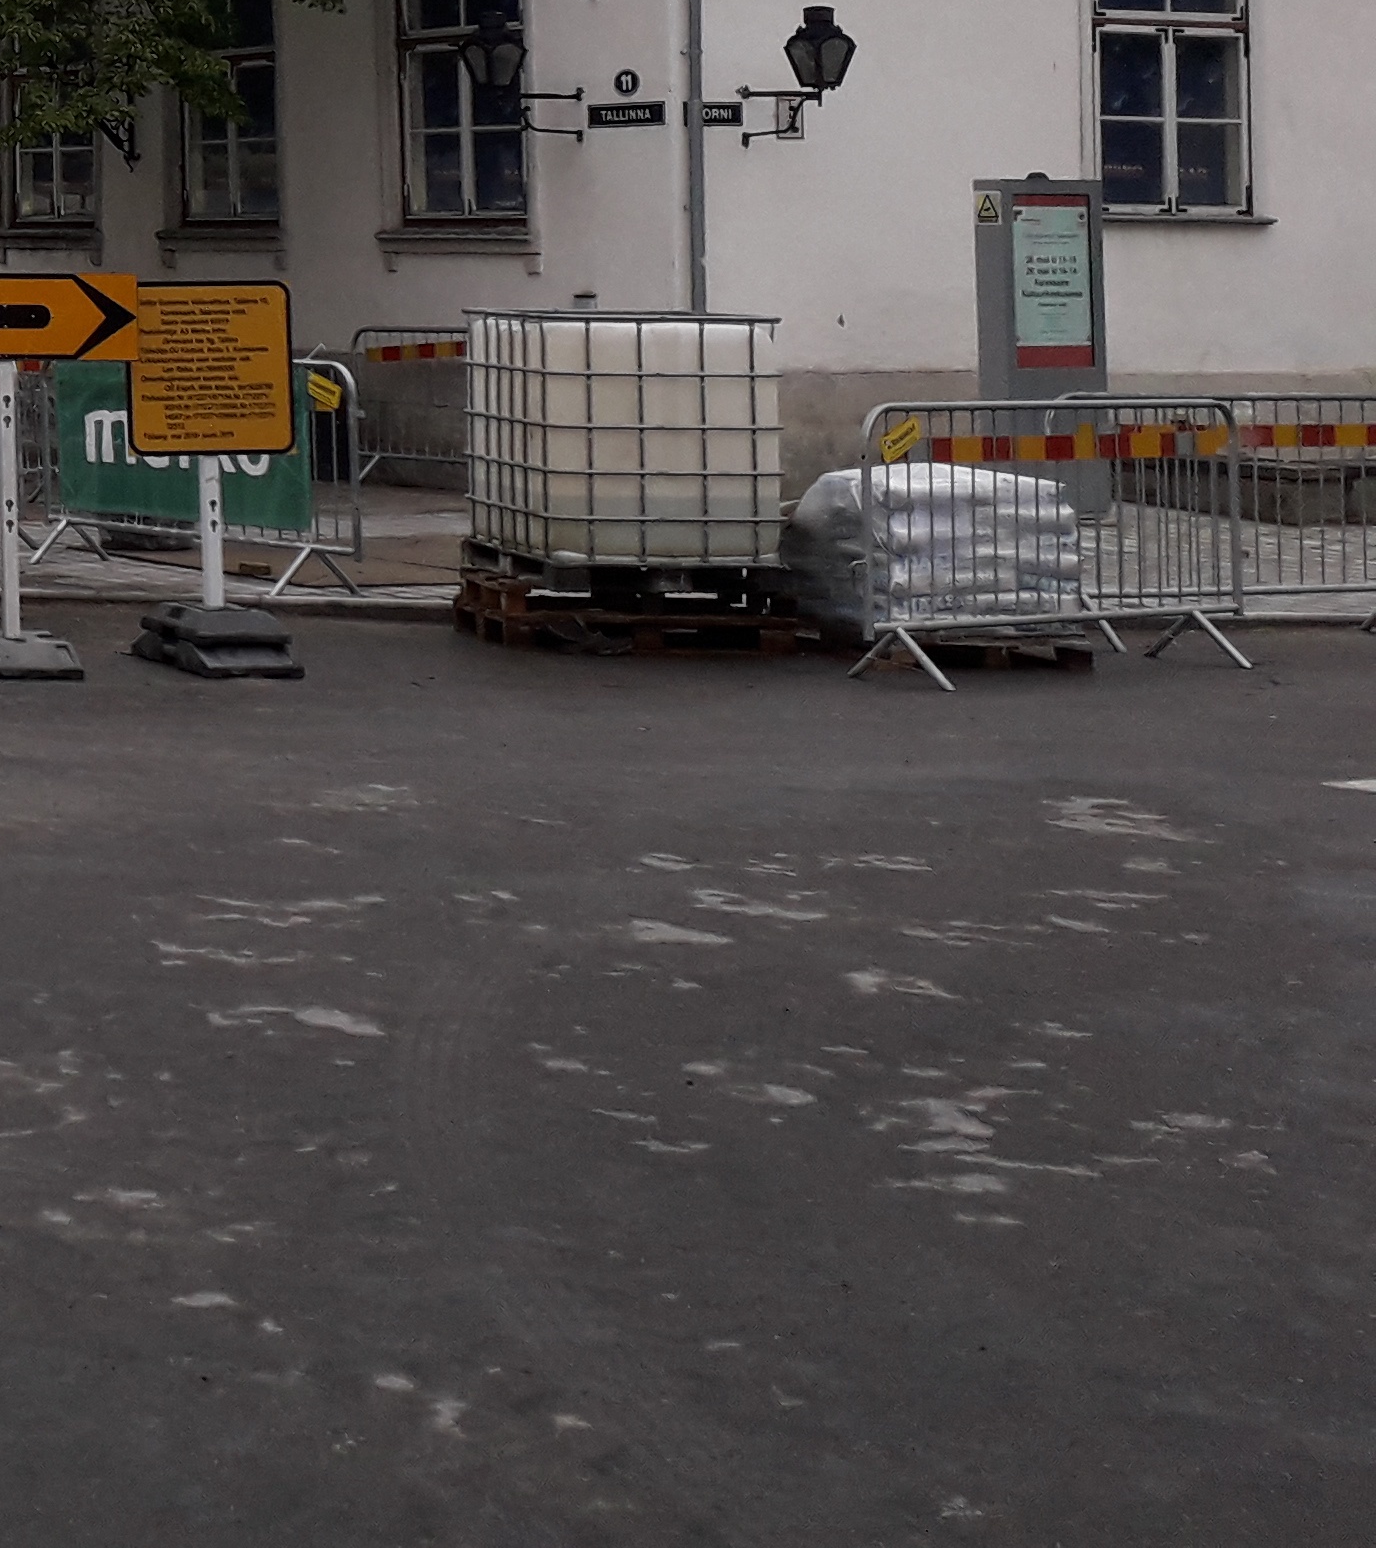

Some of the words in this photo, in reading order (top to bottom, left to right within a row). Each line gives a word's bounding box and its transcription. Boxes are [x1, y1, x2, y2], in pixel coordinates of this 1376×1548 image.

[620, 74, 633, 91] 11
[600, 107, 652, 121] TALLINNA
[702, 108, 733, 120] ORNI
